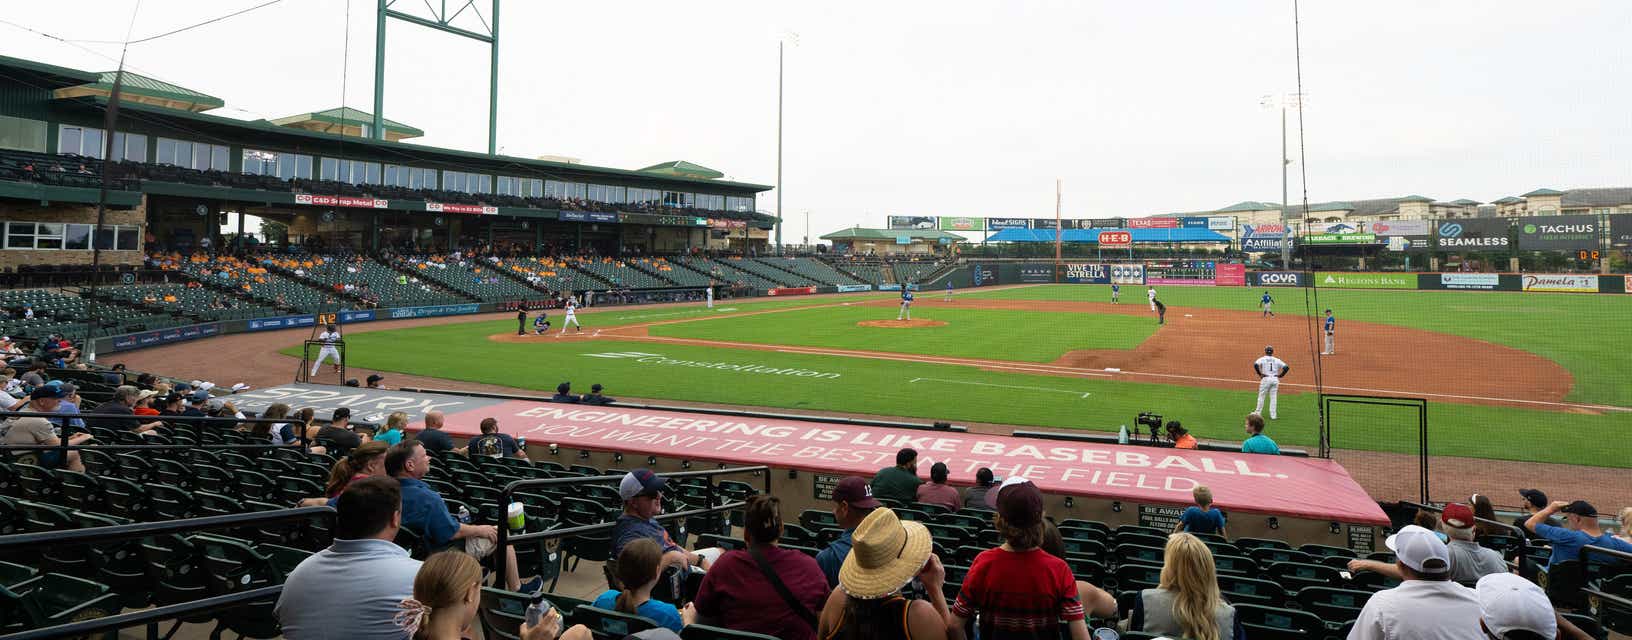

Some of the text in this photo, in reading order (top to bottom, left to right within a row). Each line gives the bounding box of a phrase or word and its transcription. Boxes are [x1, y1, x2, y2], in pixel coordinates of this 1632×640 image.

[1540, 224, 1594, 233] TACHUS
[1440, 237, 1508, 247] SEAMLESS
[1068, 264, 1087, 272] VIVE
[1067, 271, 1105, 279] ESTRELLA
[1261, 274, 1297, 284] GOYA
[1523, 275, 1575, 290] Pamela
[634, 355, 841, 379] Constellation
[514, 406, 1288, 480] ENGINEERING IS LIKE BASEBALL.
[527, 423, 603, 438] YOU
[602, 429, 720, 448] WANT
[714, 438, 801, 456] THE
[791, 446, 898, 465] BEST
[964, 457, 1056, 481] THE
